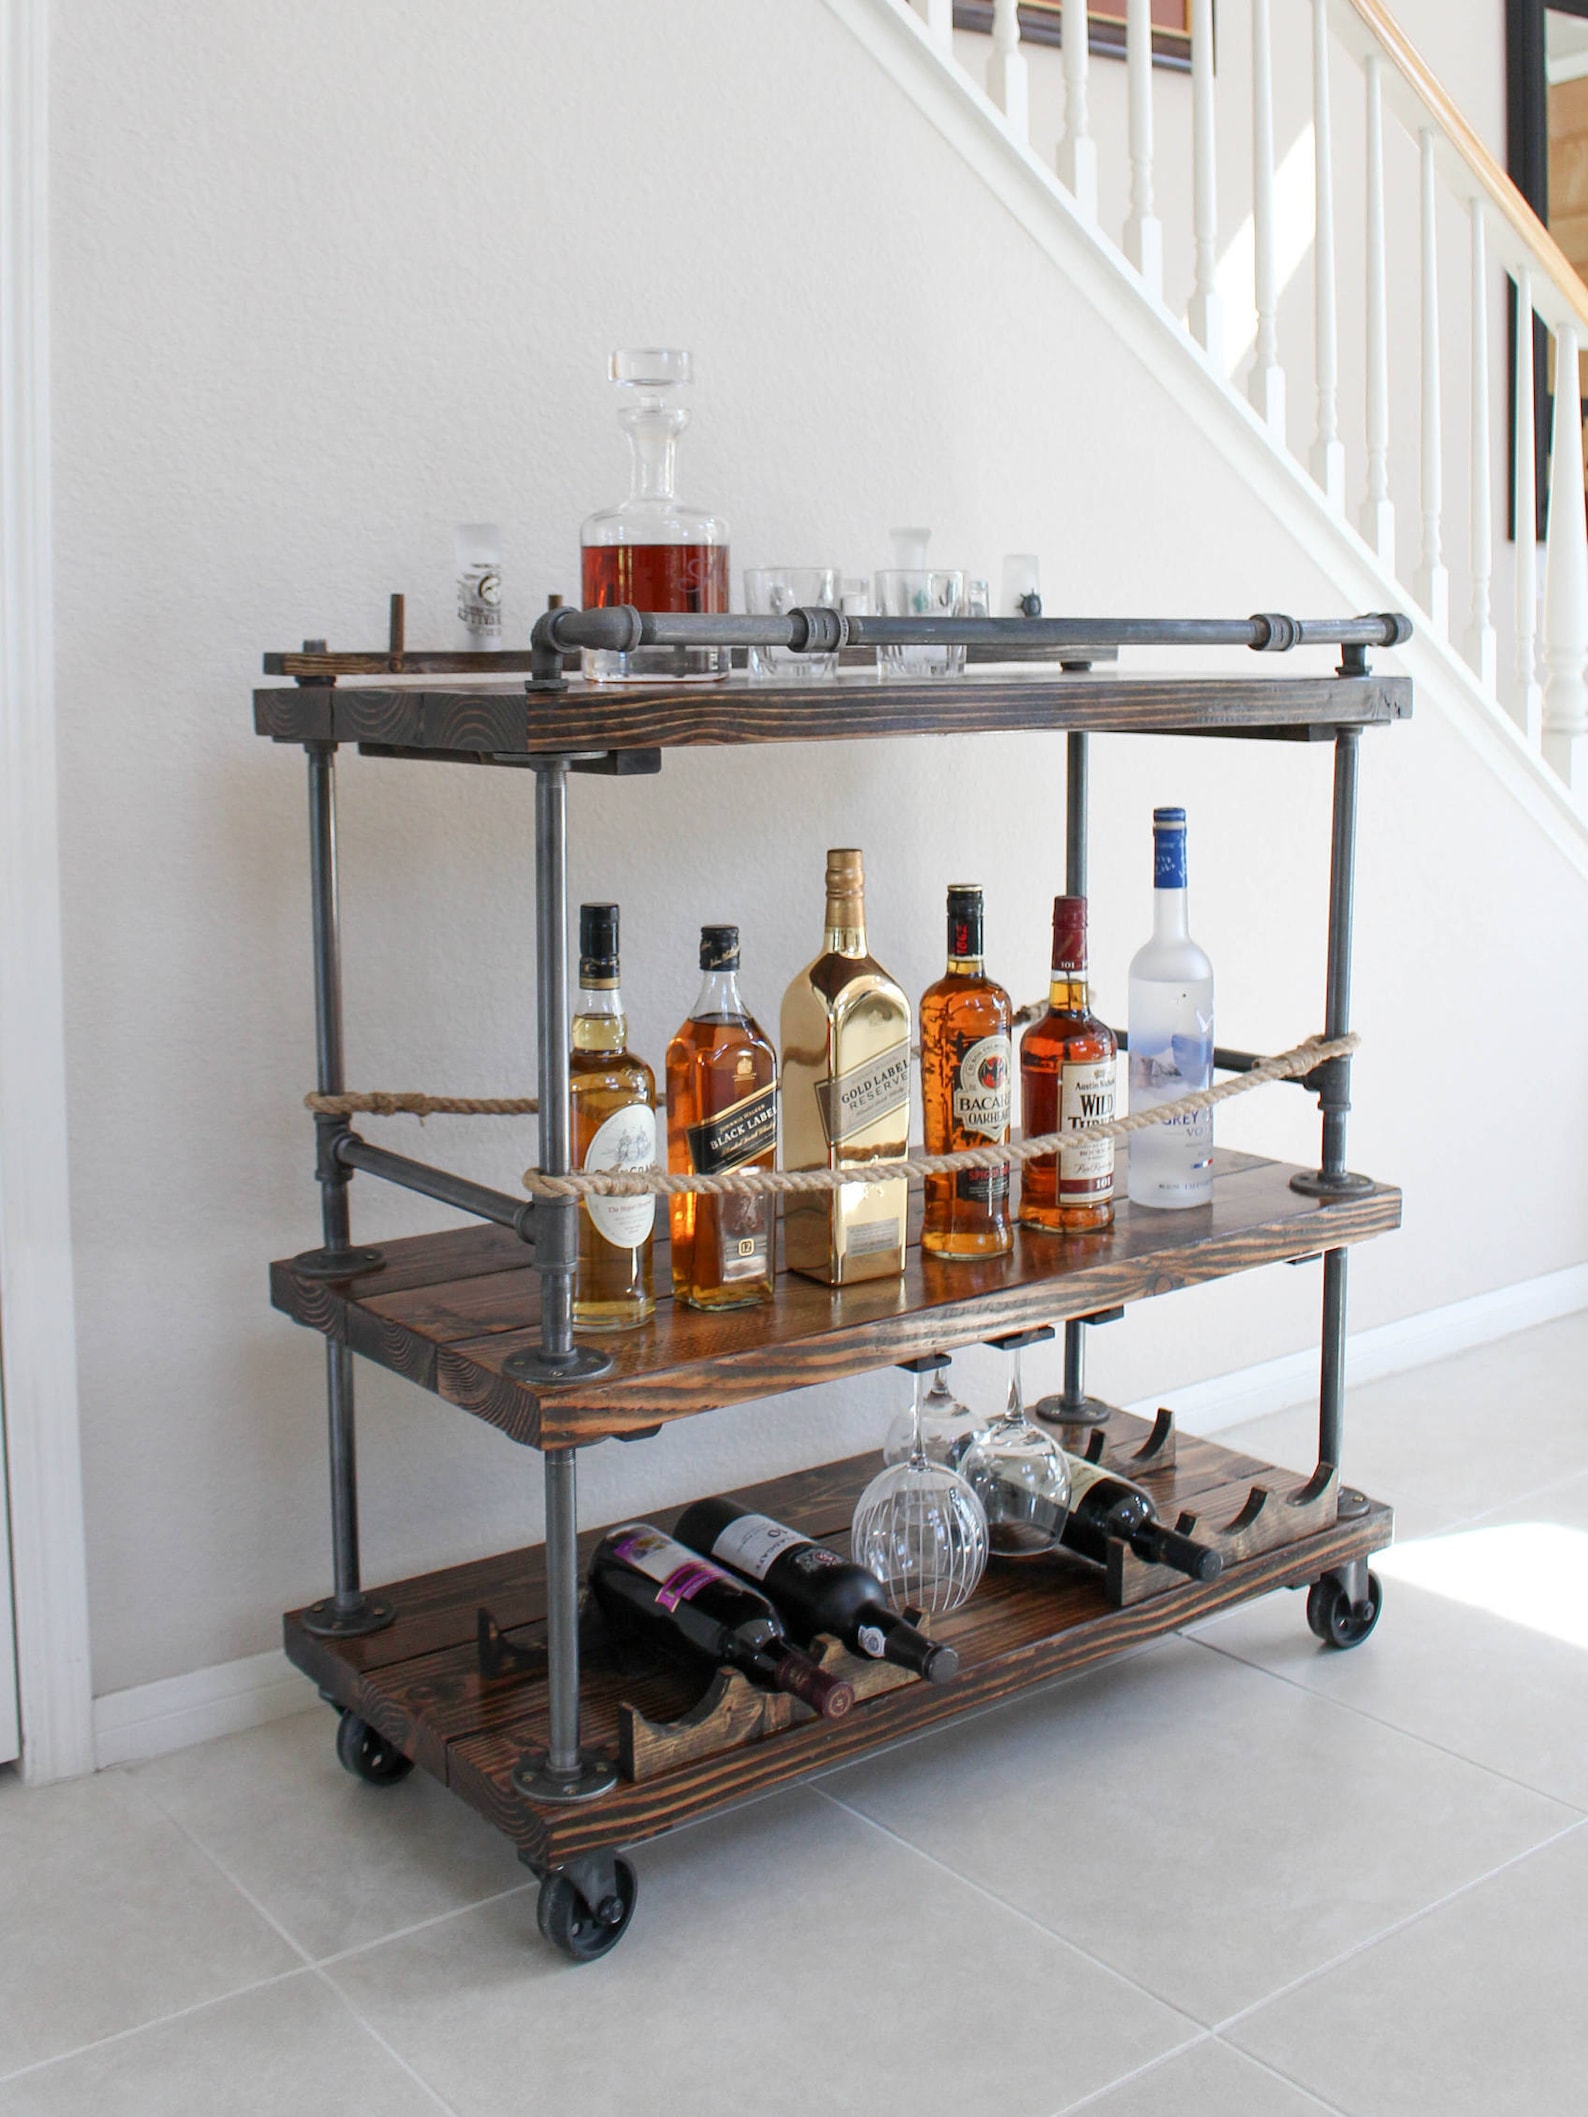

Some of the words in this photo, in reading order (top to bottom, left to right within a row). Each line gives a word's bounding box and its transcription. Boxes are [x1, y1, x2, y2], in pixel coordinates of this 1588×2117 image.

[841, 1080, 873, 1104] GOLD
[873, 1059, 909, 1086] LABEL
[849, 1071, 909, 1111] RESERVE
[1080, 1093, 1113, 1117] WILD
[710, 1124, 746, 1150] BLACK
[746, 1105, 777, 1130] LABEL
[1096, 1175, 1111, 1190] 101
